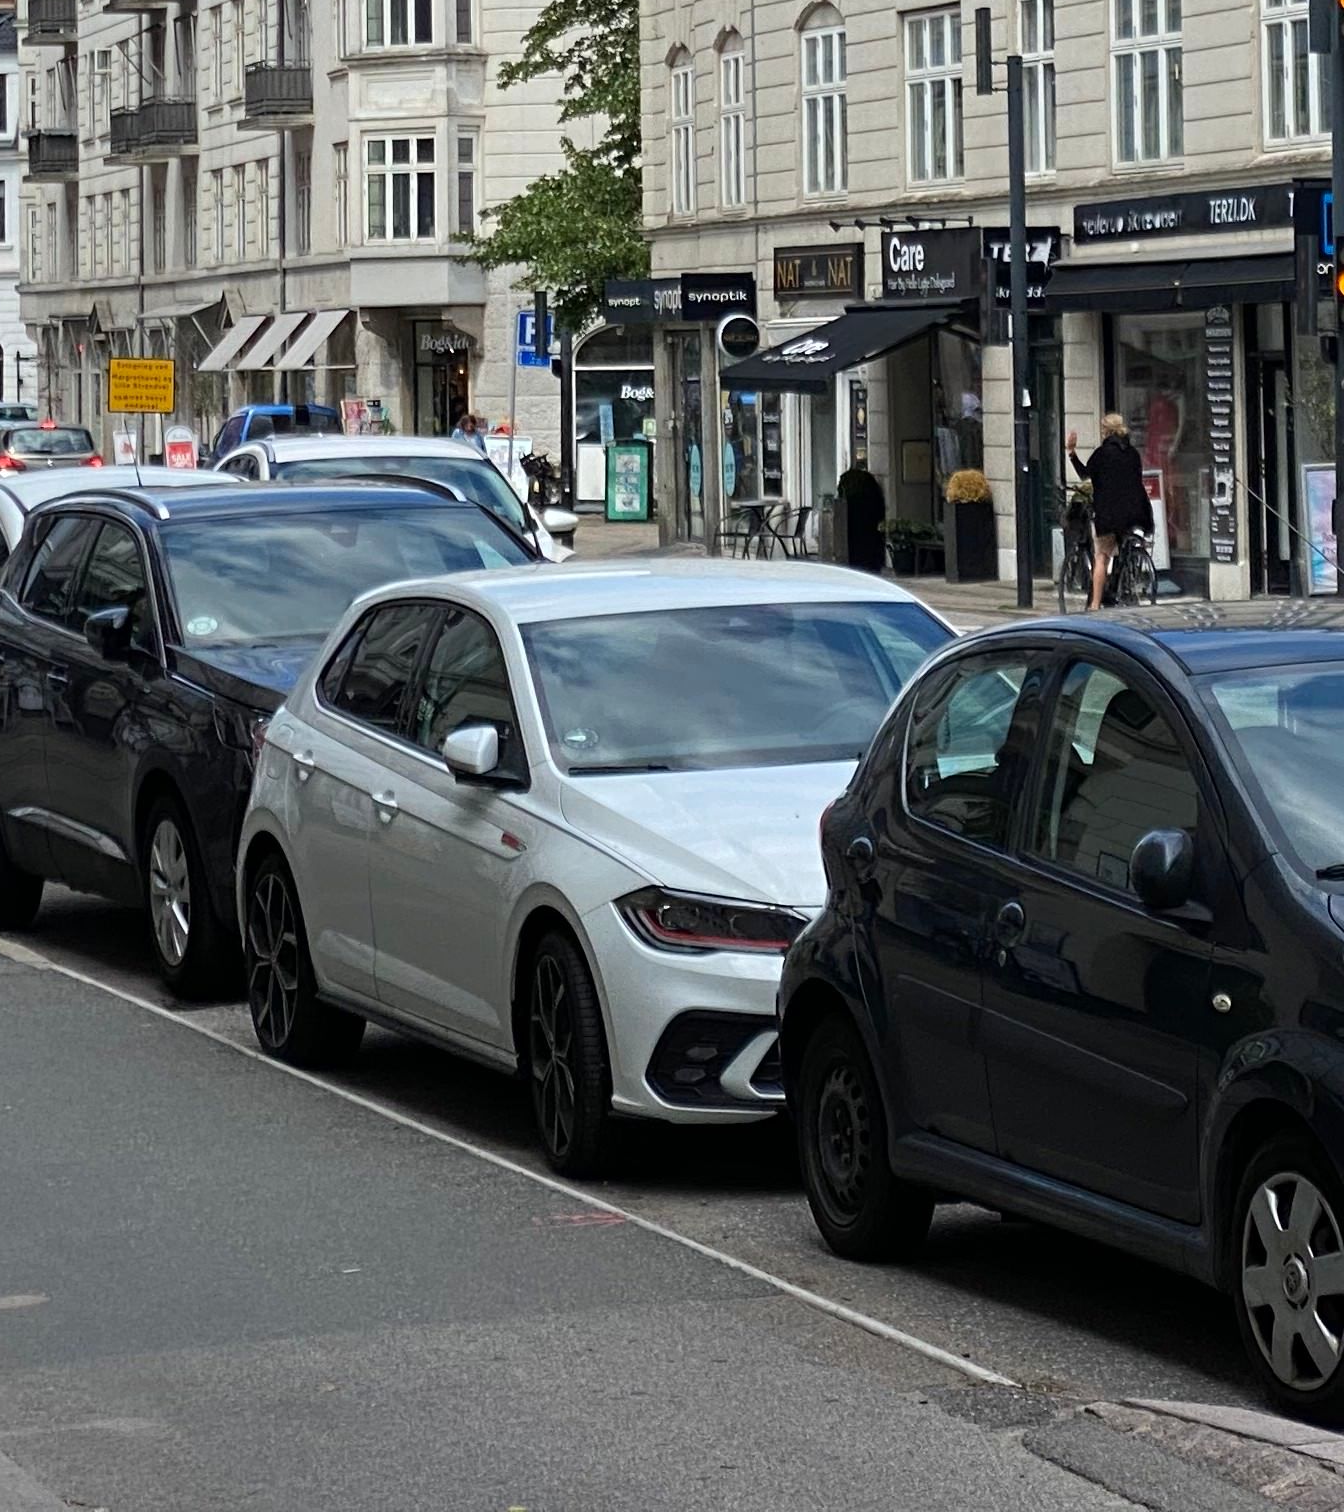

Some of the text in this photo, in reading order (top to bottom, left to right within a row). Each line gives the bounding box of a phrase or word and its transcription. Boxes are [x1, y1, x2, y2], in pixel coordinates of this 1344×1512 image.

[1209, 192, 1256, 225] TERZI.DK
[889, 236, 924, 272] Care
[777, 256, 853, 288] NAT NAT
[688, 290, 748, 303] synoptik
